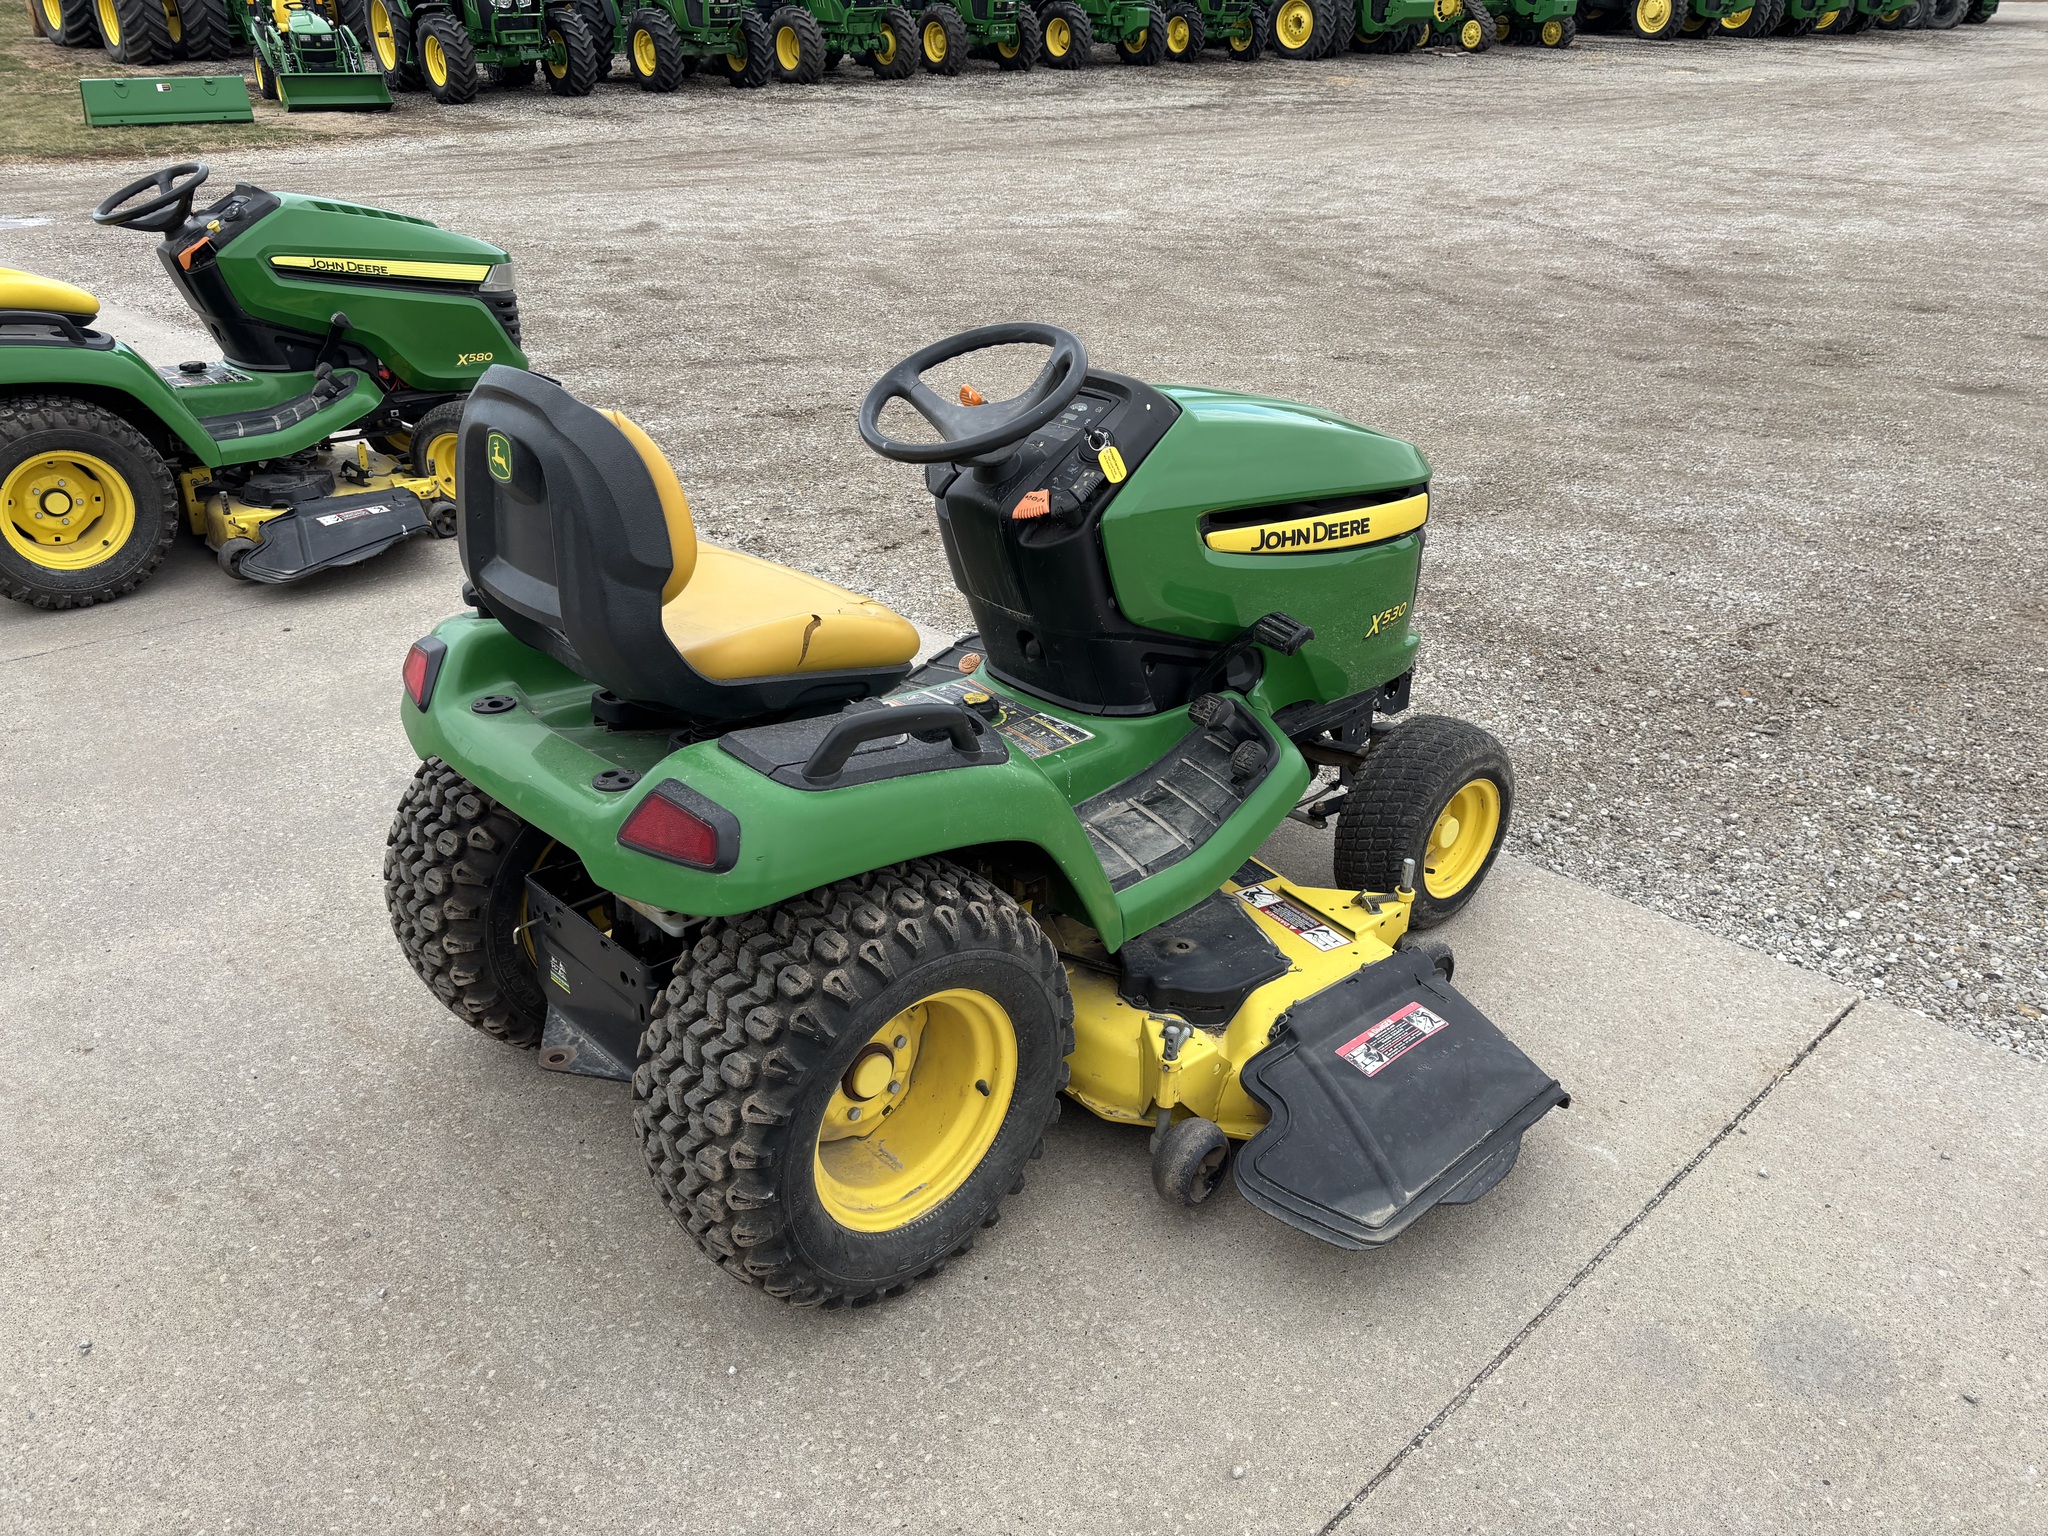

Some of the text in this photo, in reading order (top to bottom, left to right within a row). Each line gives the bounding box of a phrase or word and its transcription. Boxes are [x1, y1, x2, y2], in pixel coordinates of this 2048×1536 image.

[309, 258, 389, 275] JOHN DEERE
[456, 352, 493, 366] X580
[1250, 517, 1371, 552] JOHN DEERE
[1363, 601, 1407, 639] X530
